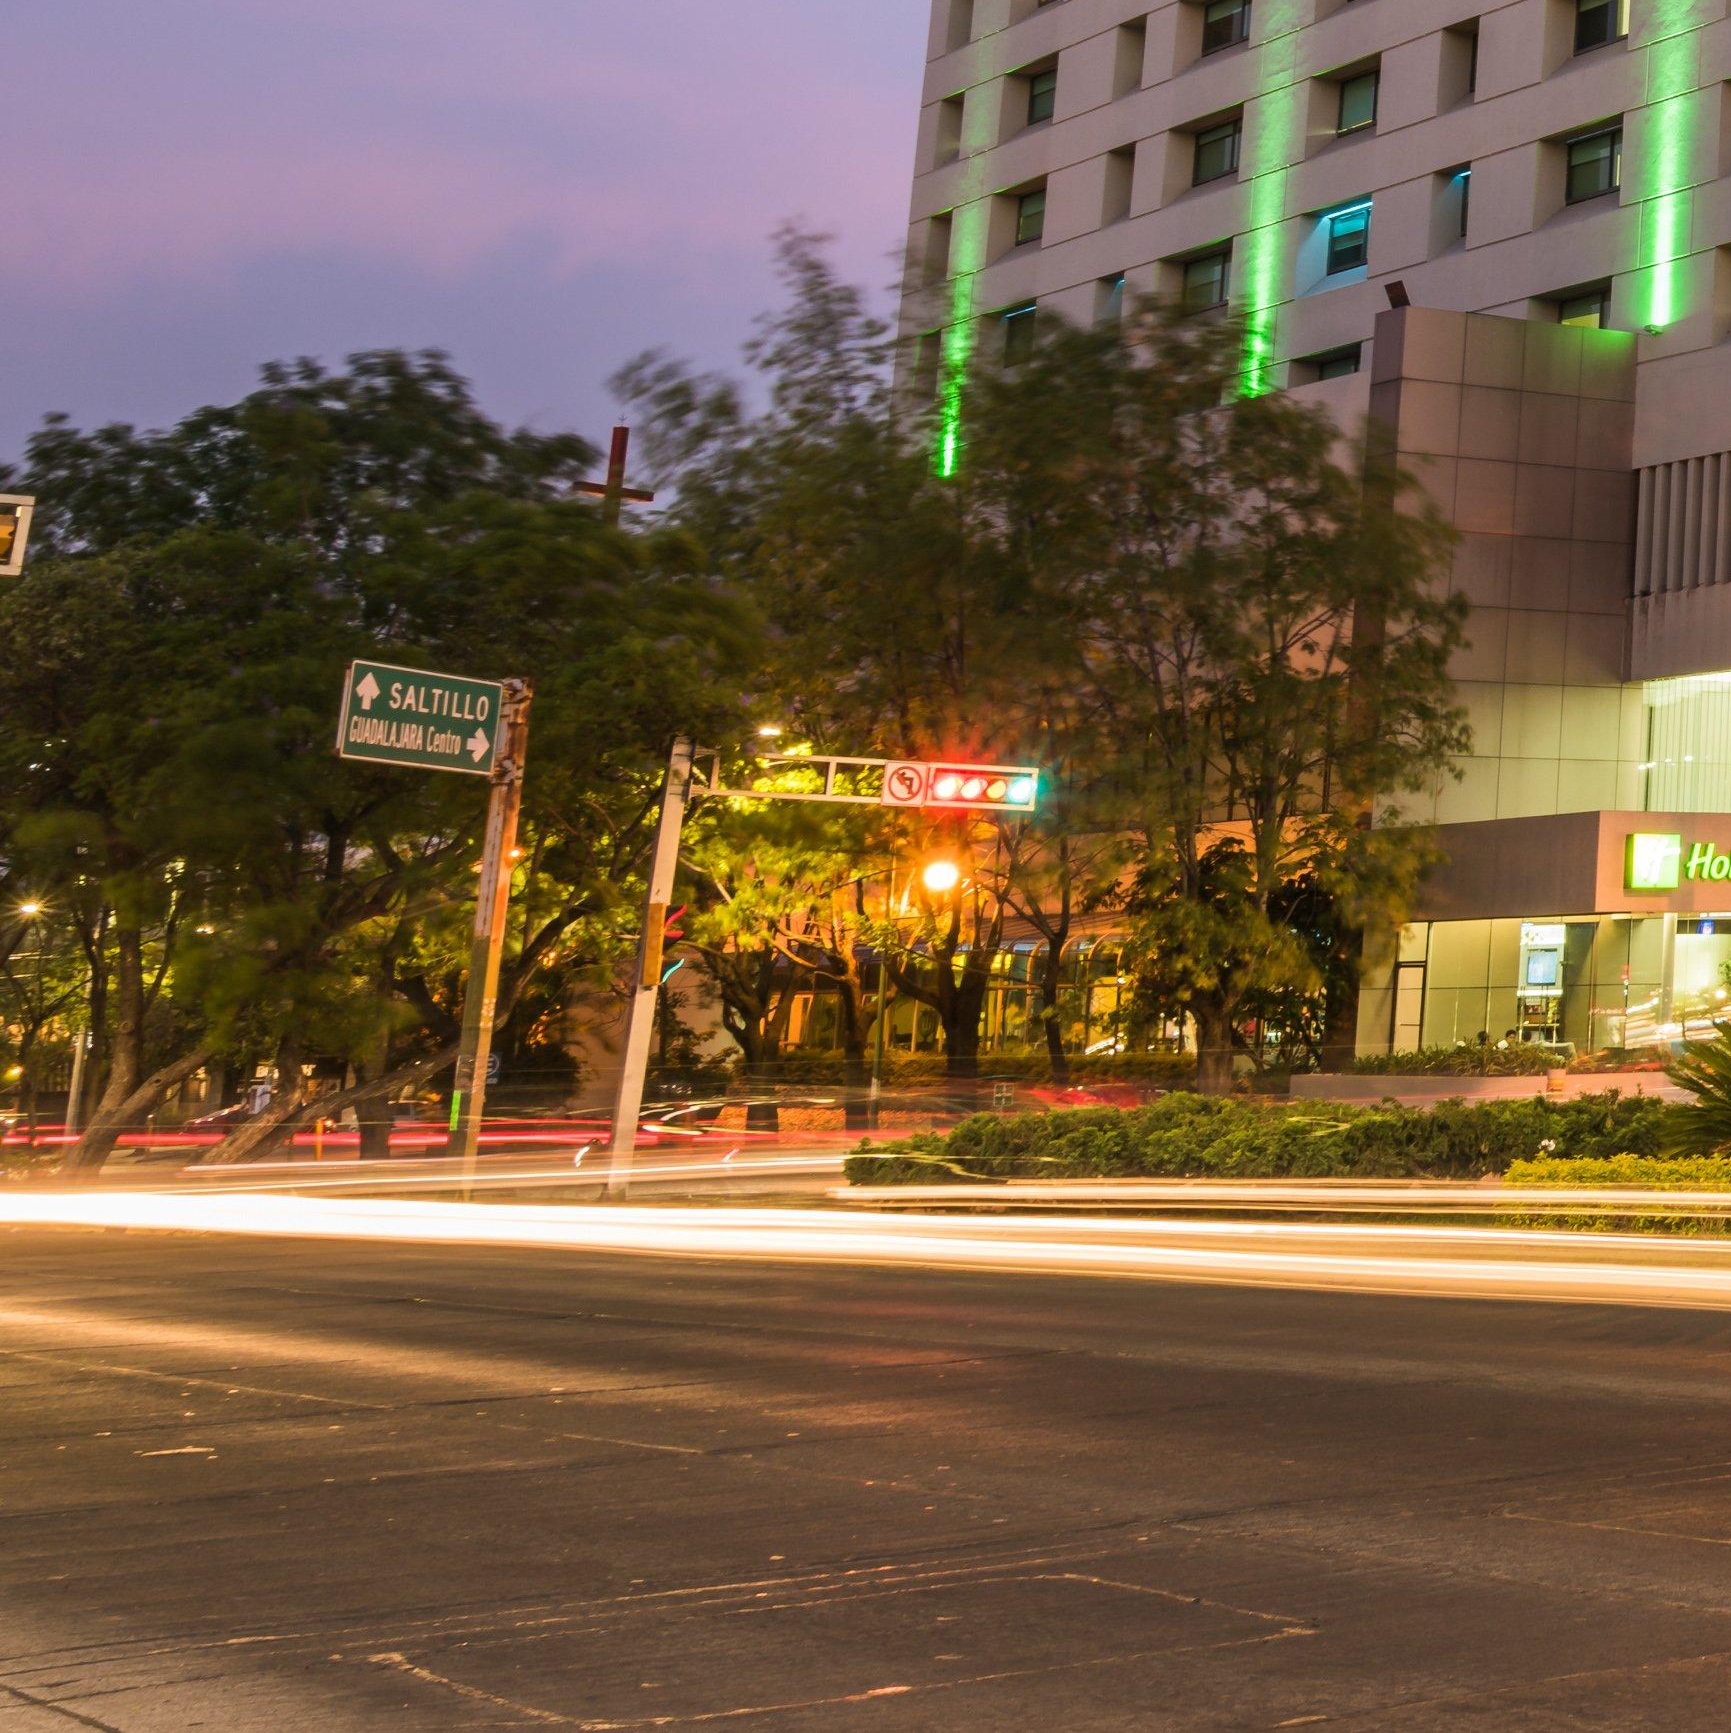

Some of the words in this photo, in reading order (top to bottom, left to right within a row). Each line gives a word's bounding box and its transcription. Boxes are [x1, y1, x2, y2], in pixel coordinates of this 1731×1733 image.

[388, 682, 490, 722] SALTILLO
[349, 715, 424, 751] GUADALAJARA
[426, 725, 462, 755] Centro
